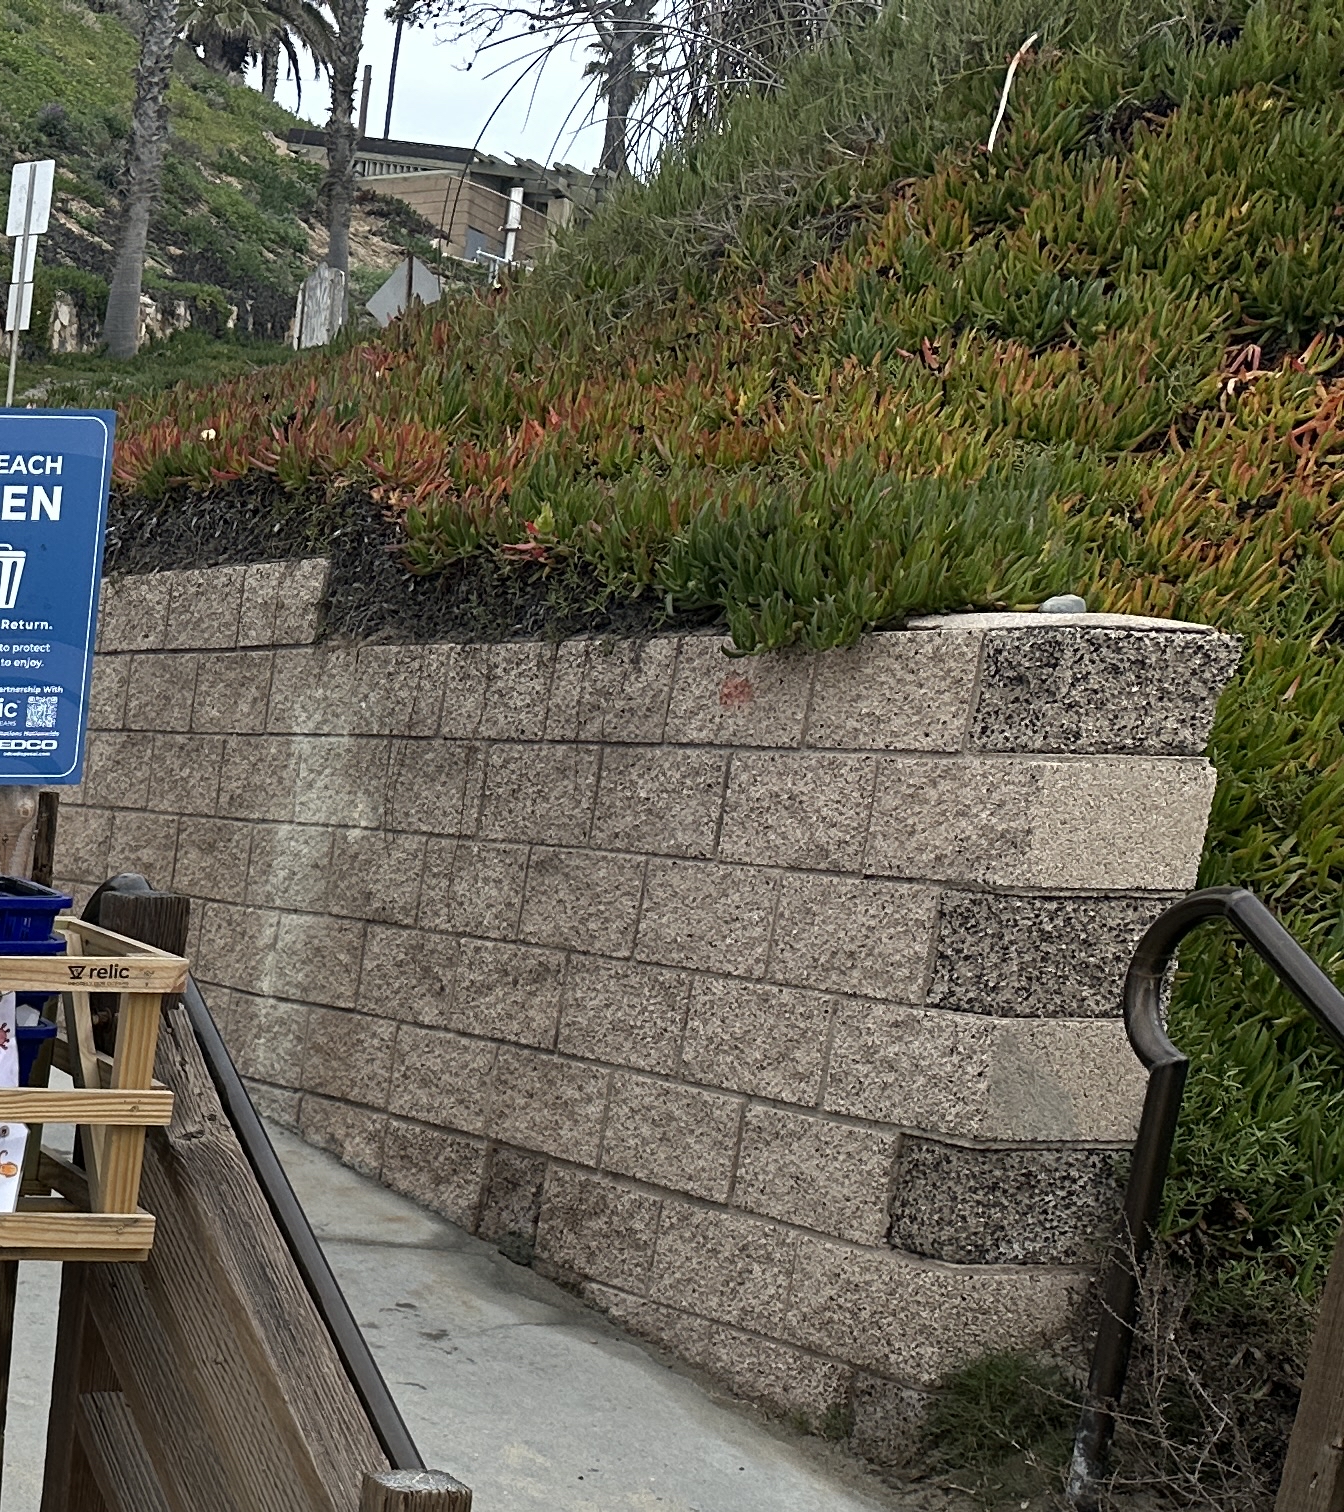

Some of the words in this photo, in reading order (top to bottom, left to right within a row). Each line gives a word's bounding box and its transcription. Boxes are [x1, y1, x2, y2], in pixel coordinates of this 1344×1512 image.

[0, 619, 54, 630] Return.
[0, 643, 10, 652] to
[12, 643, 51, 655] protect
[0, 658, 11, 667] to
[13, 658, 44, 669] enjoy.
[43, 685, 64, 693] With
[89, 964, 130, 979] relic
